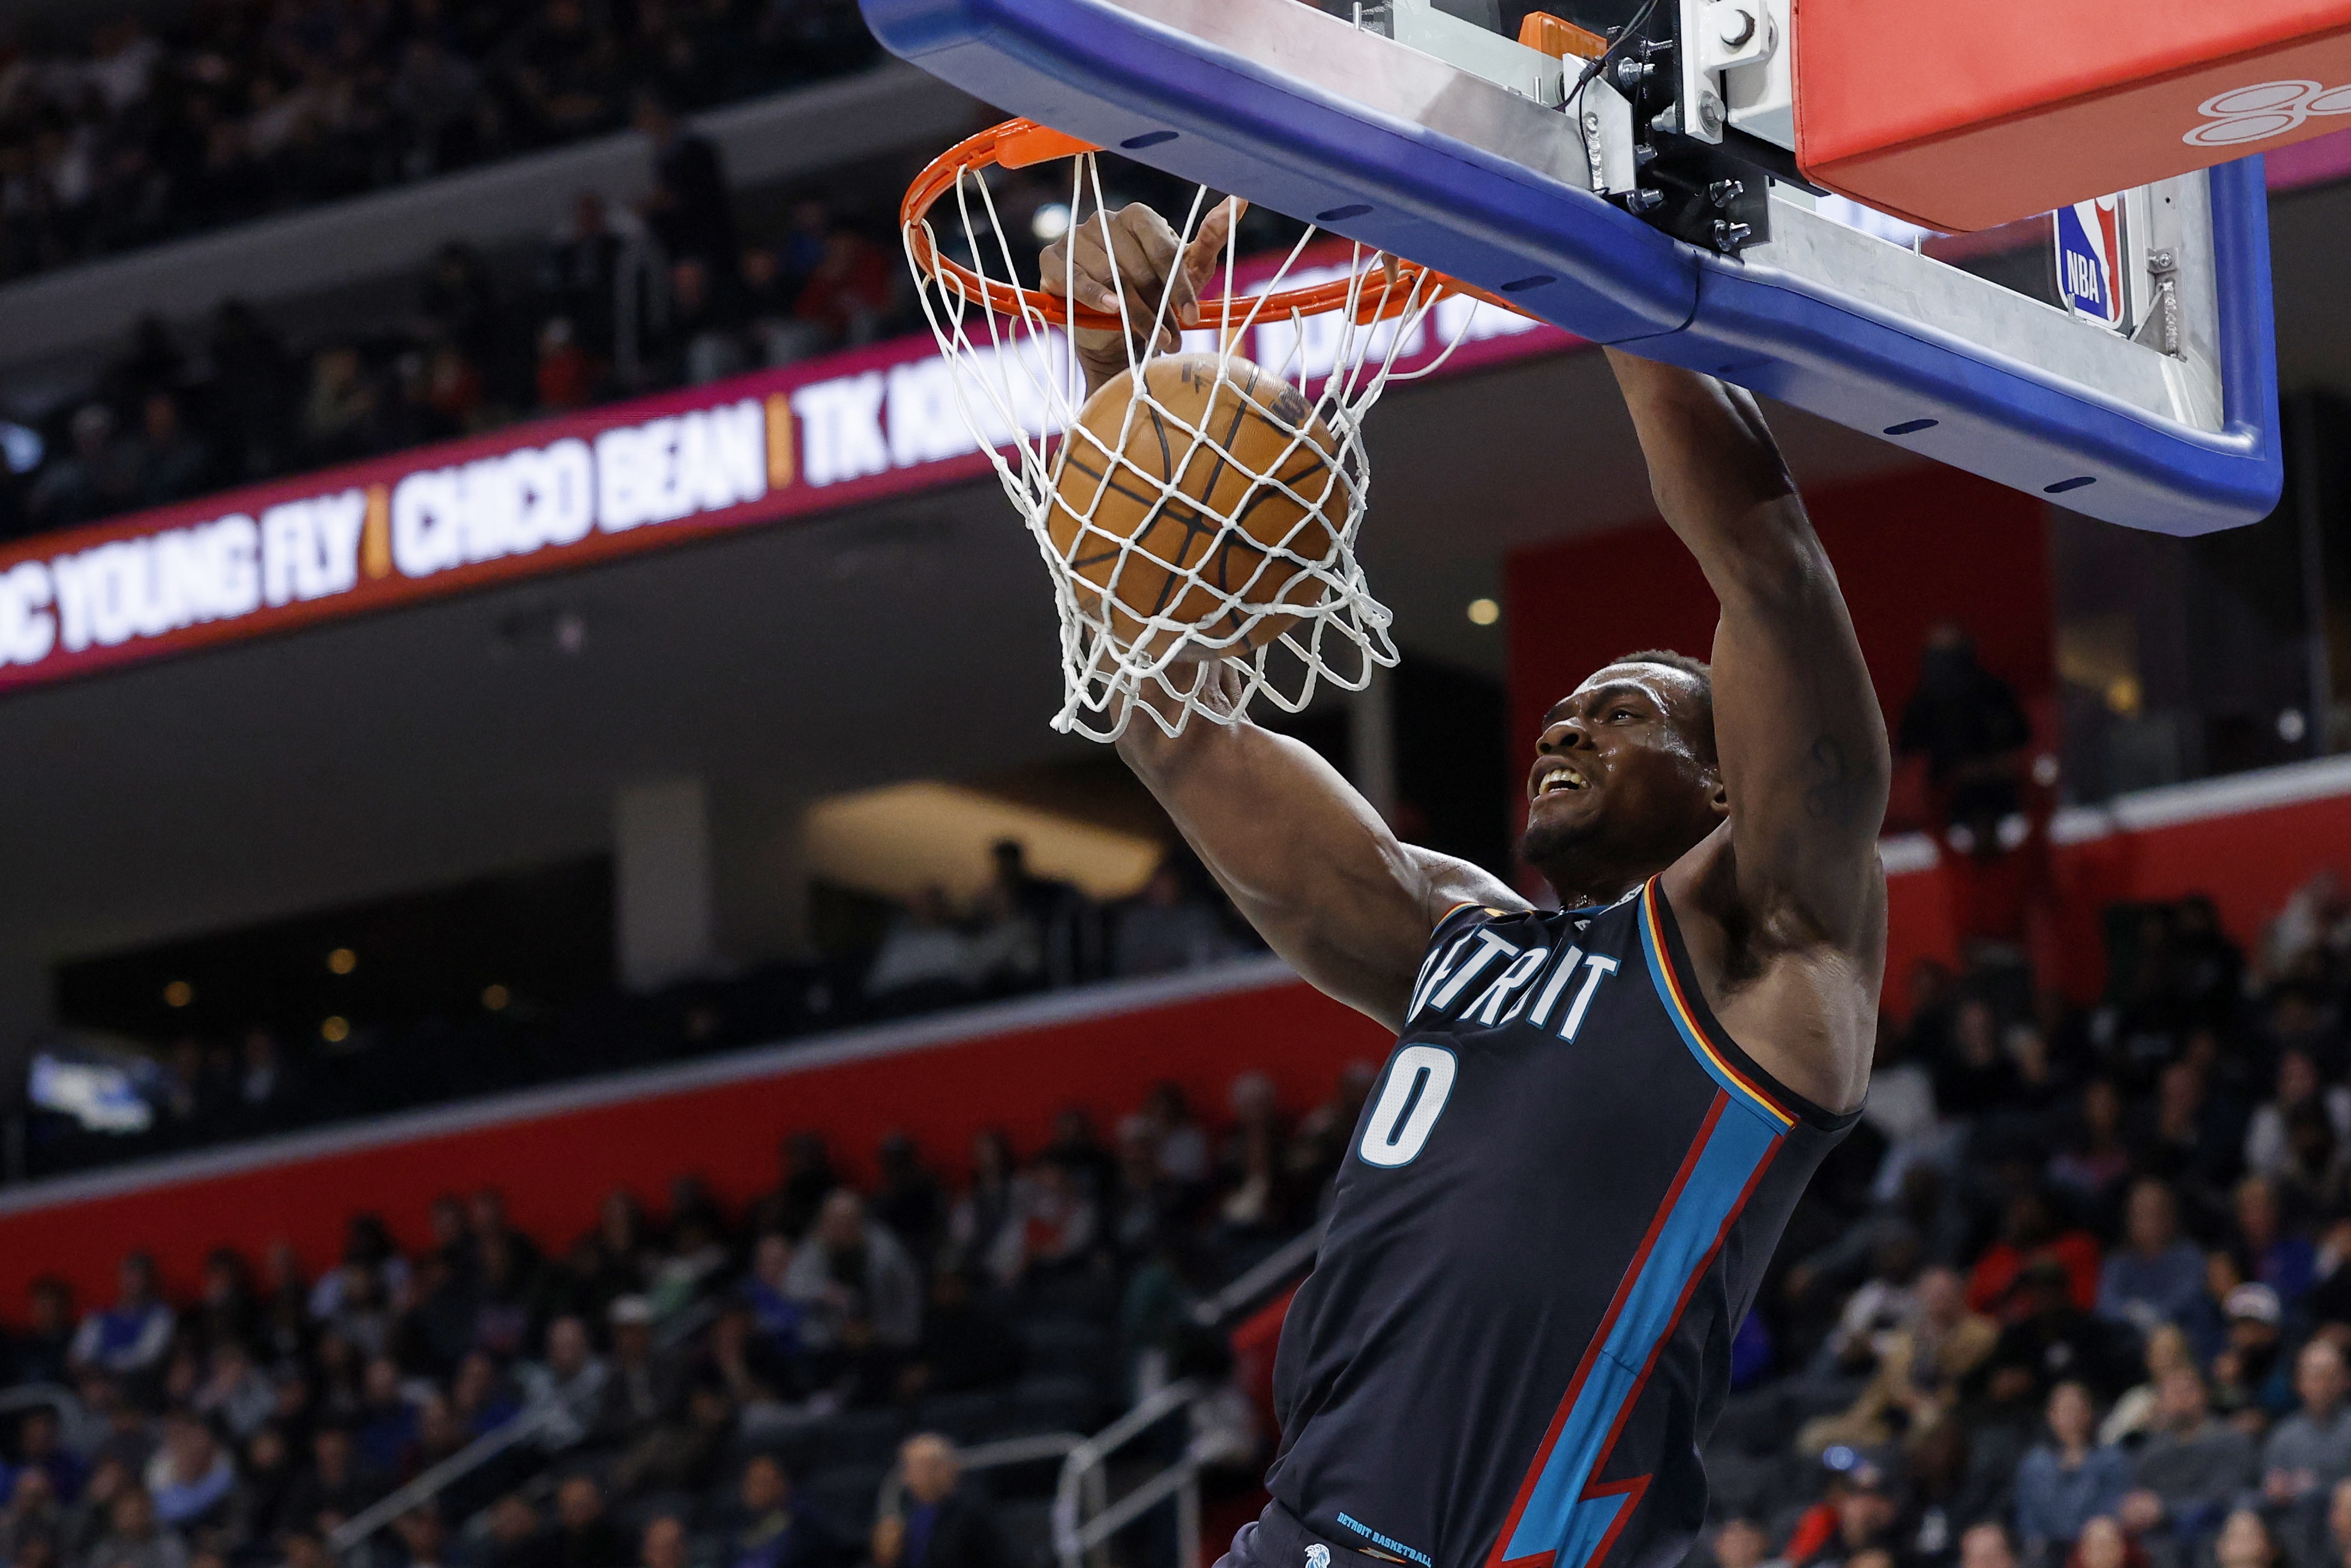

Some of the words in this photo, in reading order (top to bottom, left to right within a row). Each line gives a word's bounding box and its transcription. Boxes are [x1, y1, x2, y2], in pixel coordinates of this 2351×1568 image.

[2067, 250, 2100, 303] NBA
[0, 562, 55, 666] C
[52, 514, 259, 650] YOUNG
[260, 489, 366, 605] FLY
[392, 437, 594, 576] CHICO
[595, 398, 766, 533] BEAN
[792, 371, 889, 486] TK
[1359, 1044, 1458, 1168] 0
[1337, 1512, 1372, 1539] DETROIT
[1372, 1532, 1432, 1568] BASKETBALL
